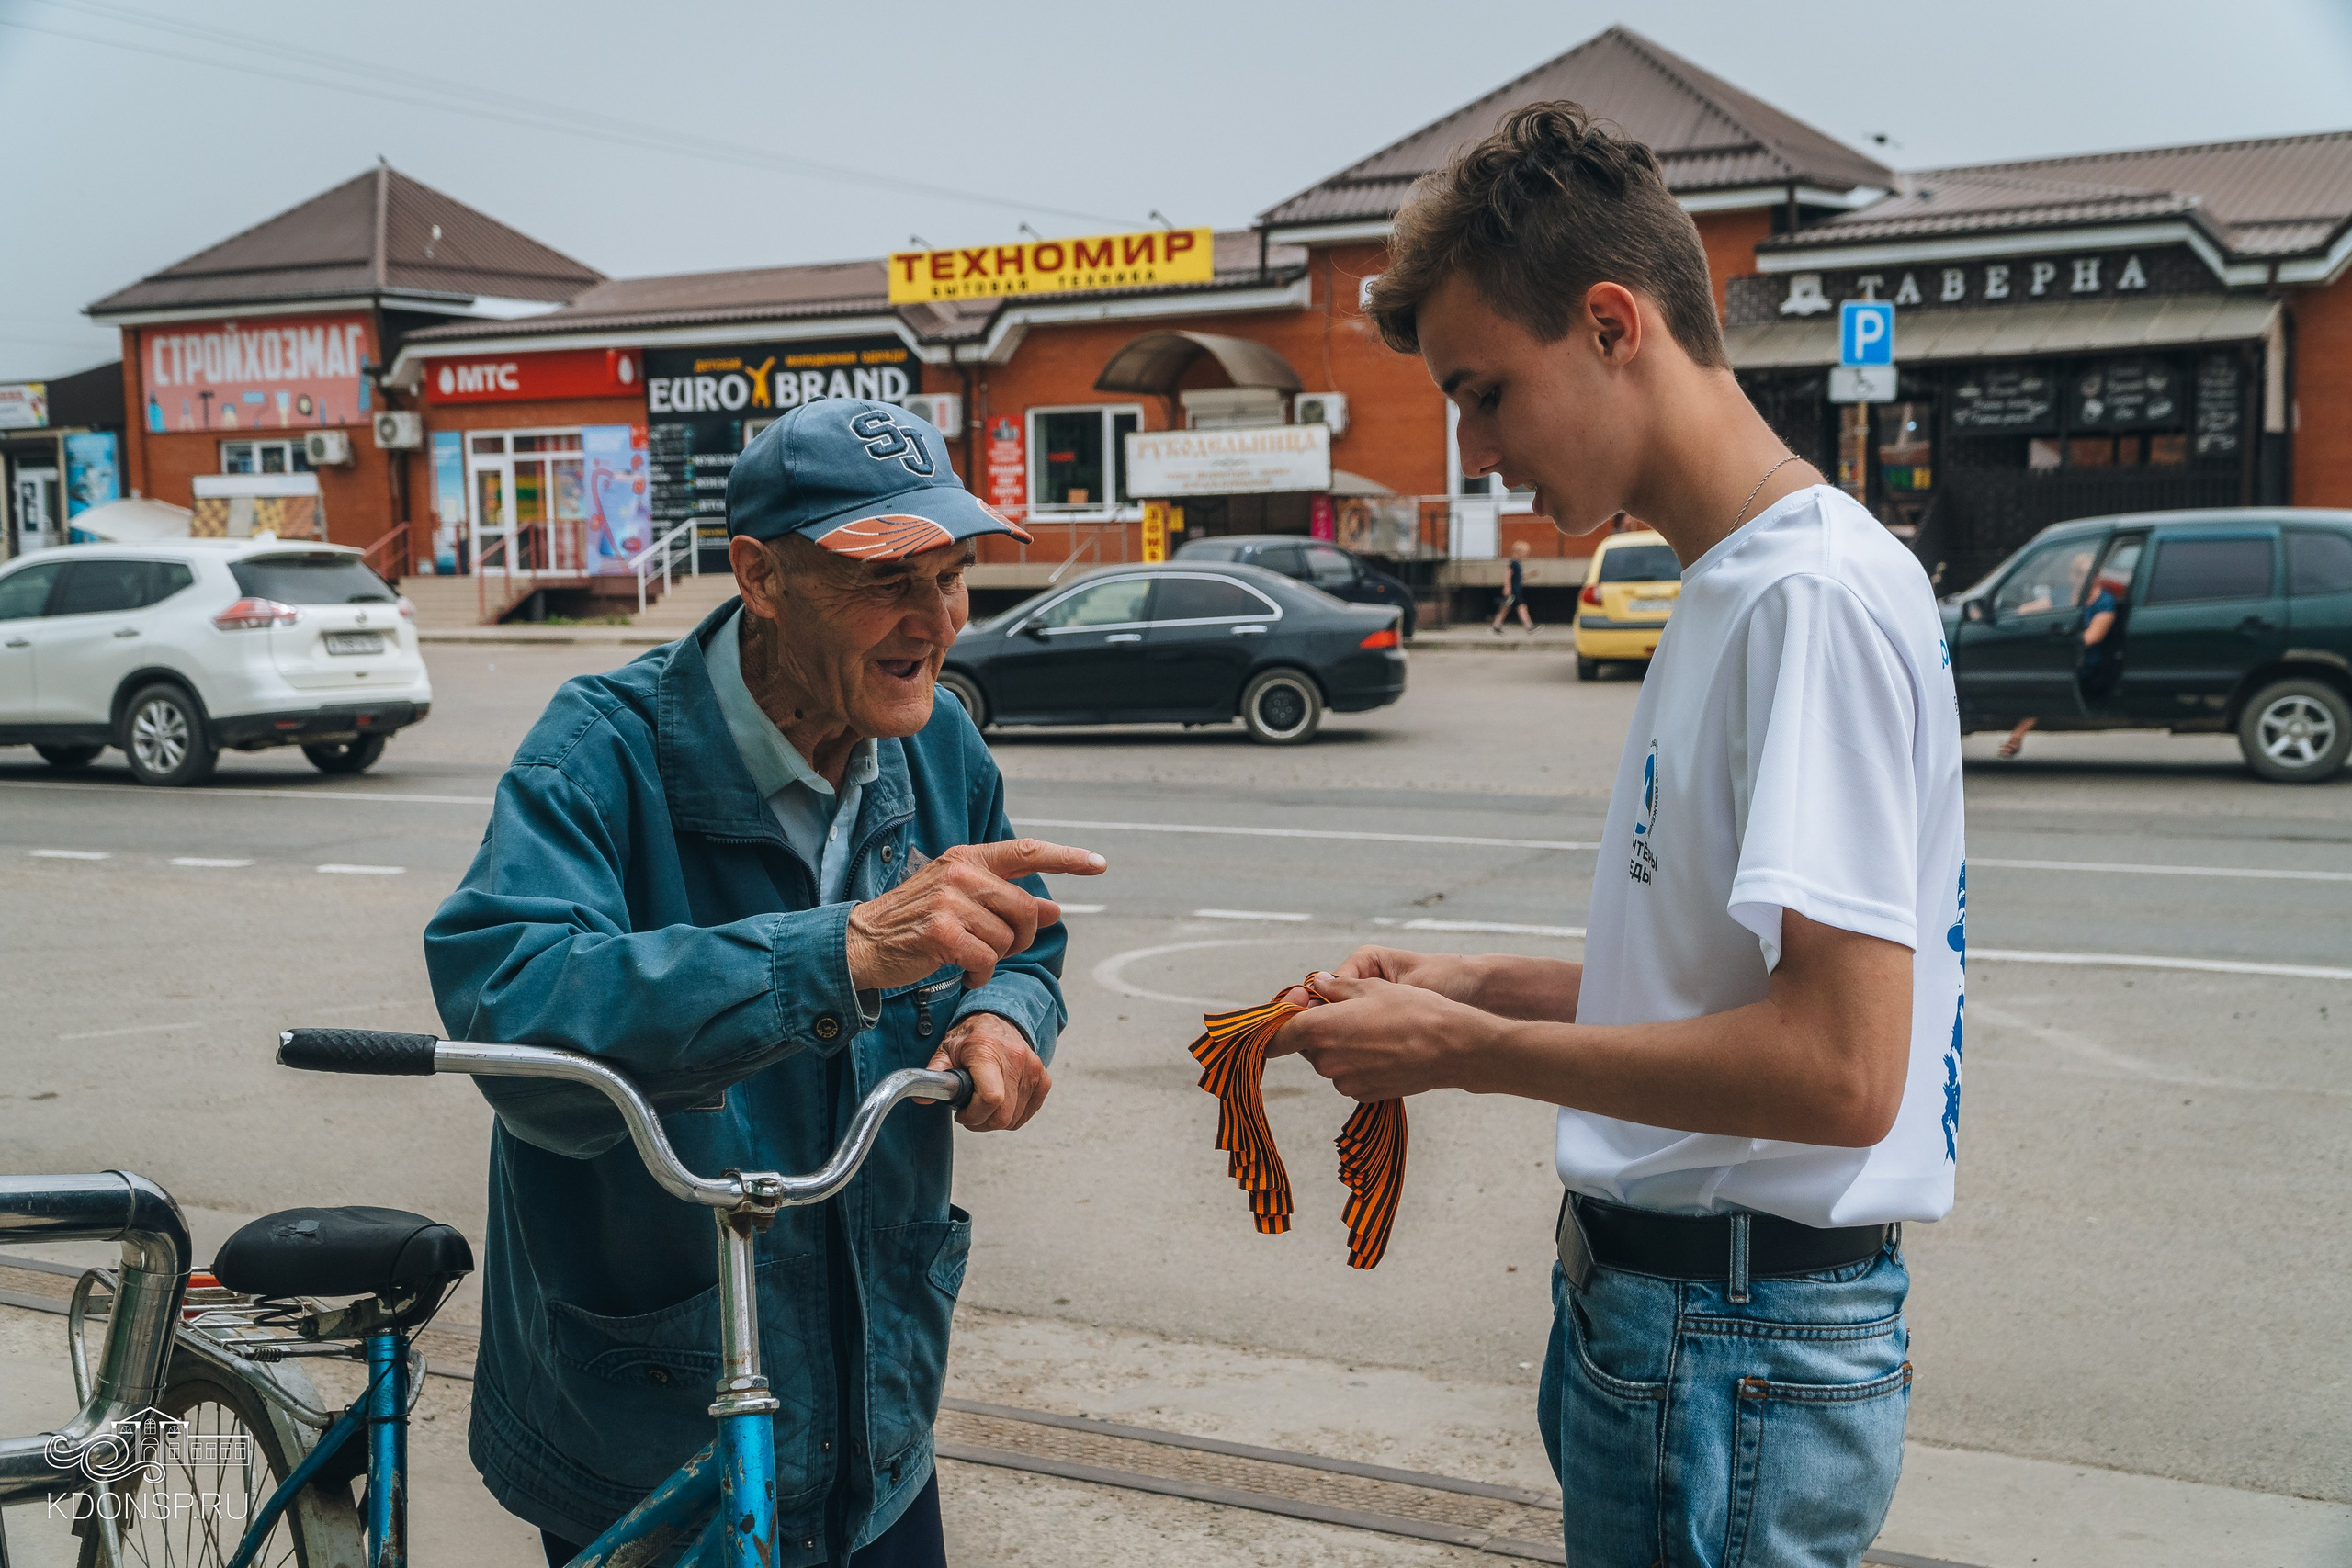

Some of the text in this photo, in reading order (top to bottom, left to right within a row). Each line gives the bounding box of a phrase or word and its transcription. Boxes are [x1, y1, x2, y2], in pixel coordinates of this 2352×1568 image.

[894, 231, 1194, 283] ТЕХНОМИР
[1857, 254, 2147, 305] ТАВЕРНА
[931, 269, 1157, 299] БЫТОВАЯ ТЕХНИКА
[153, 323, 363, 386] СТРОЙХОЗМАГ
[457, 363, 520, 392] МТС
[648, 367, 910, 413] EURO BRAND
